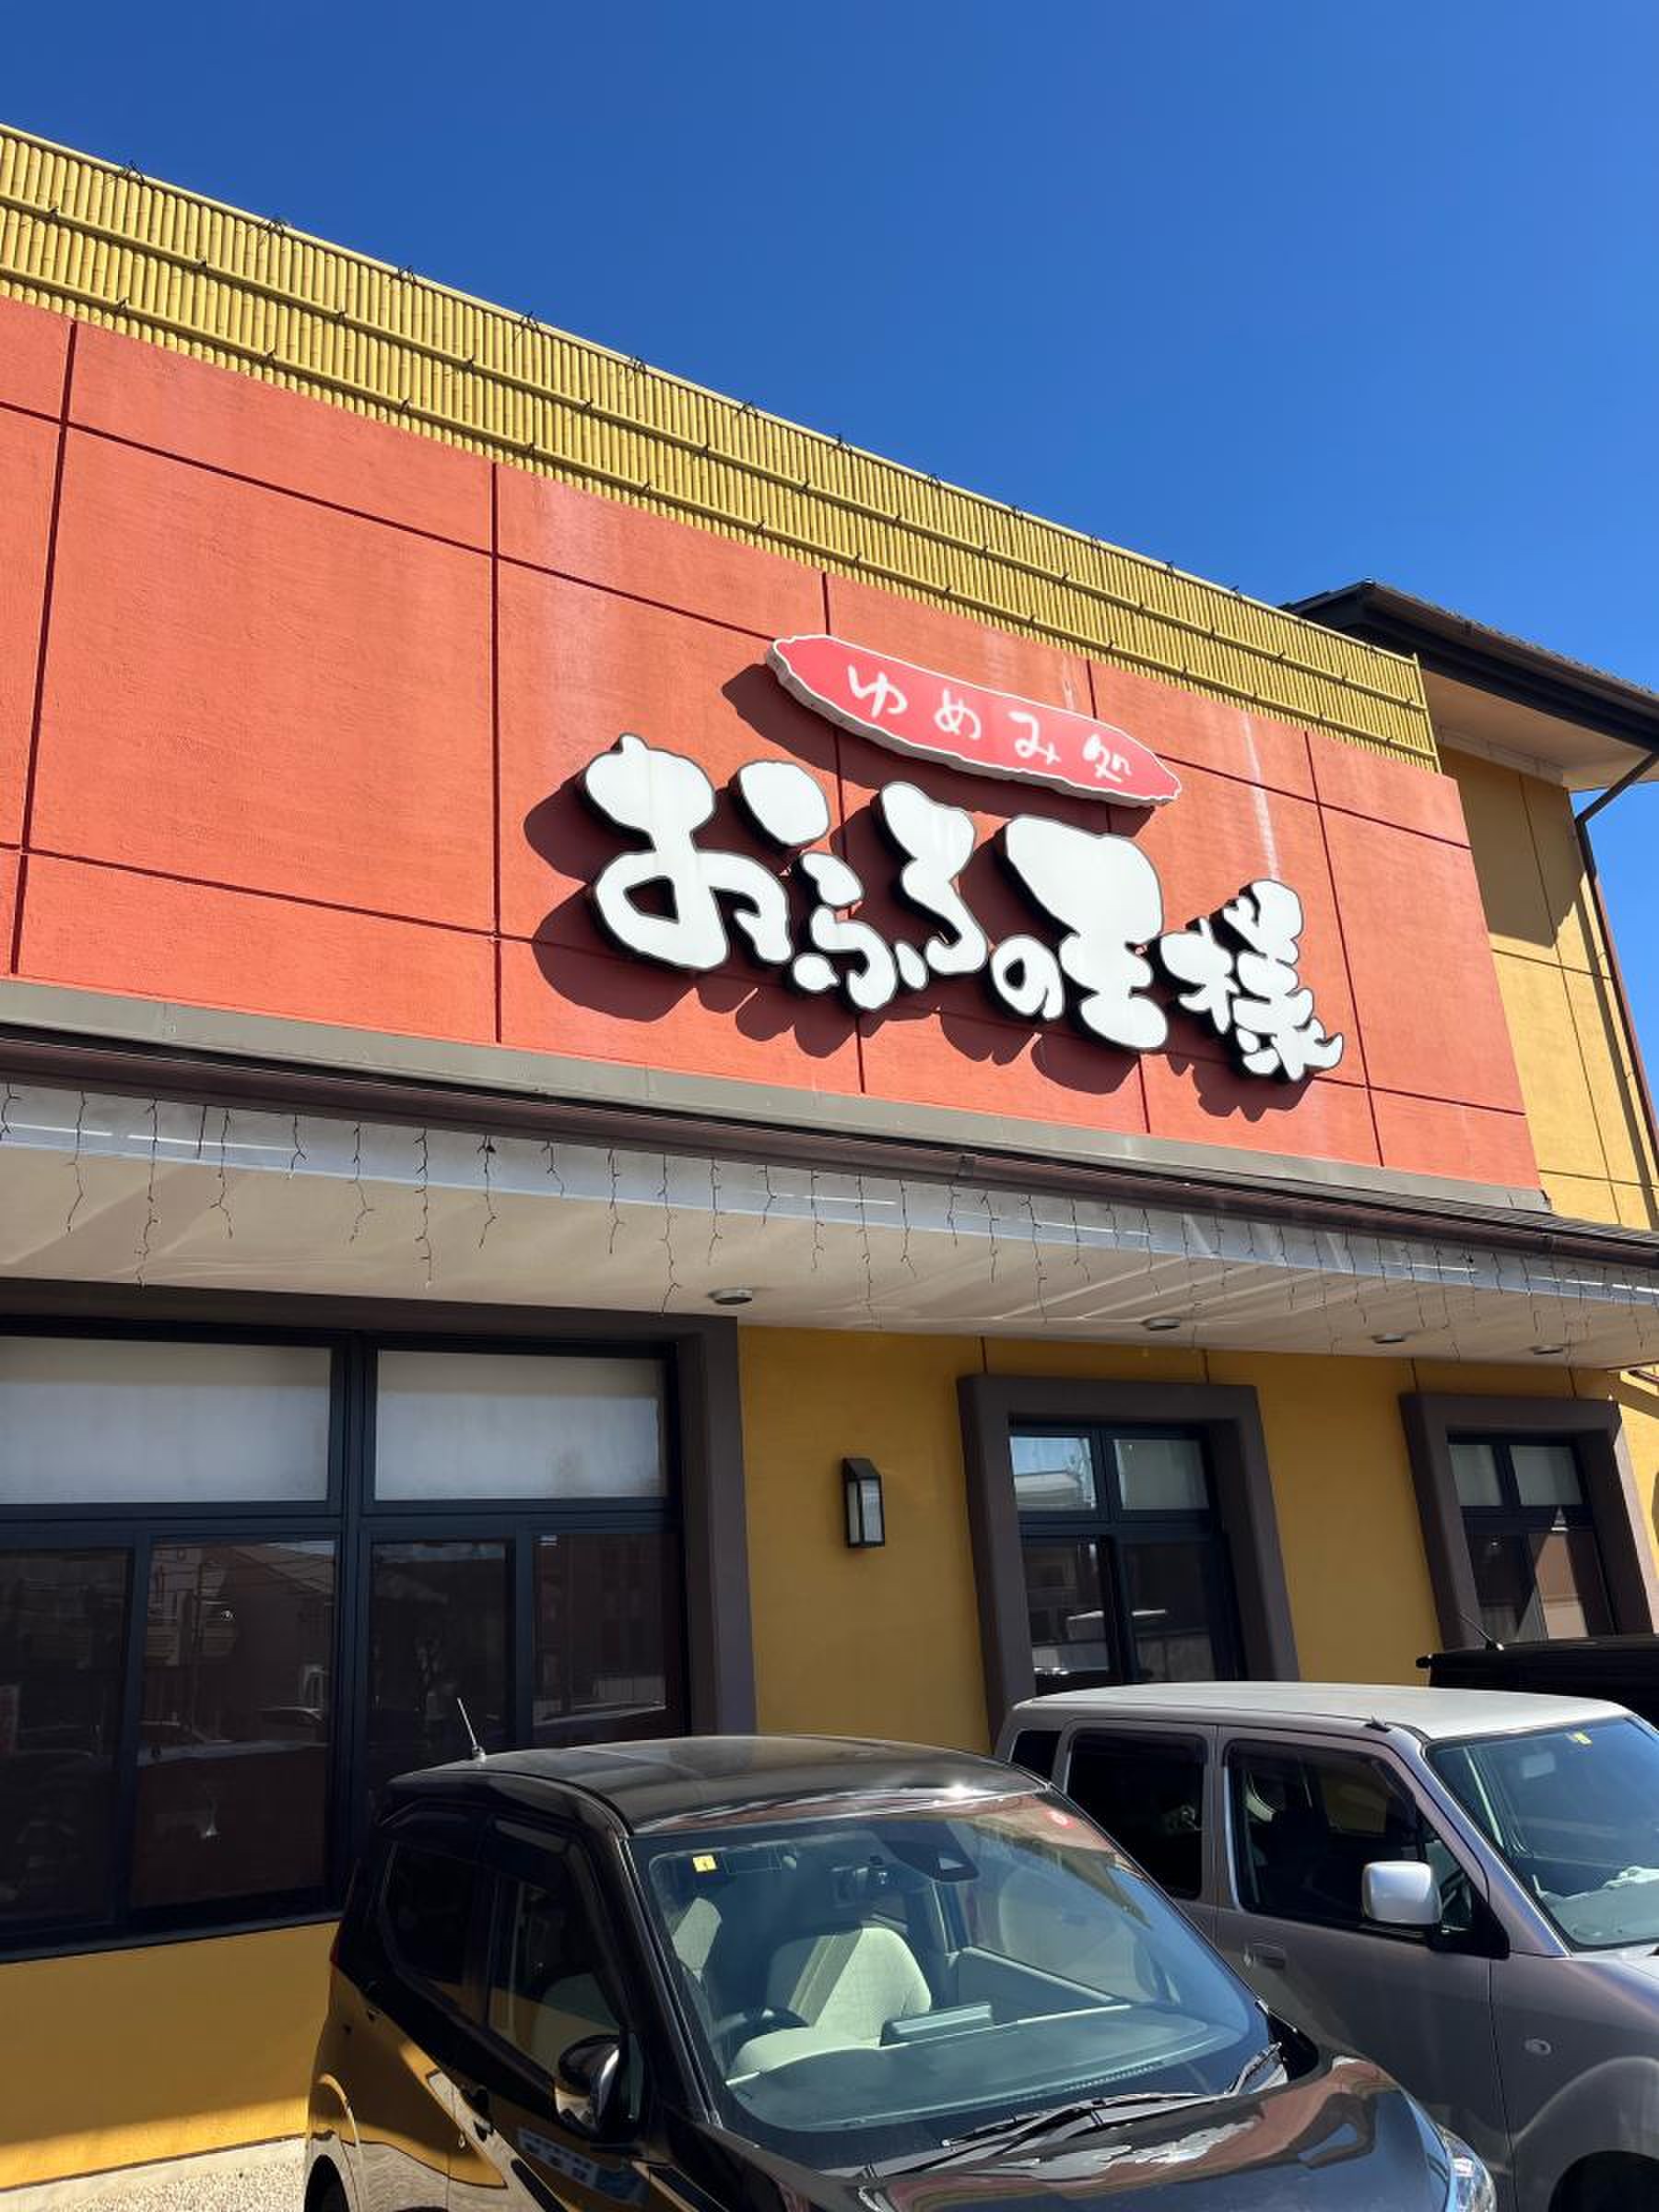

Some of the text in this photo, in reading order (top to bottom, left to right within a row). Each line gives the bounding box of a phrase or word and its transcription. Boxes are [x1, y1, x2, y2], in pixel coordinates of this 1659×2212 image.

[846, 664, 1133, 783] ゆめみ処
[584, 734, 1345, 1082] おふろの王様
